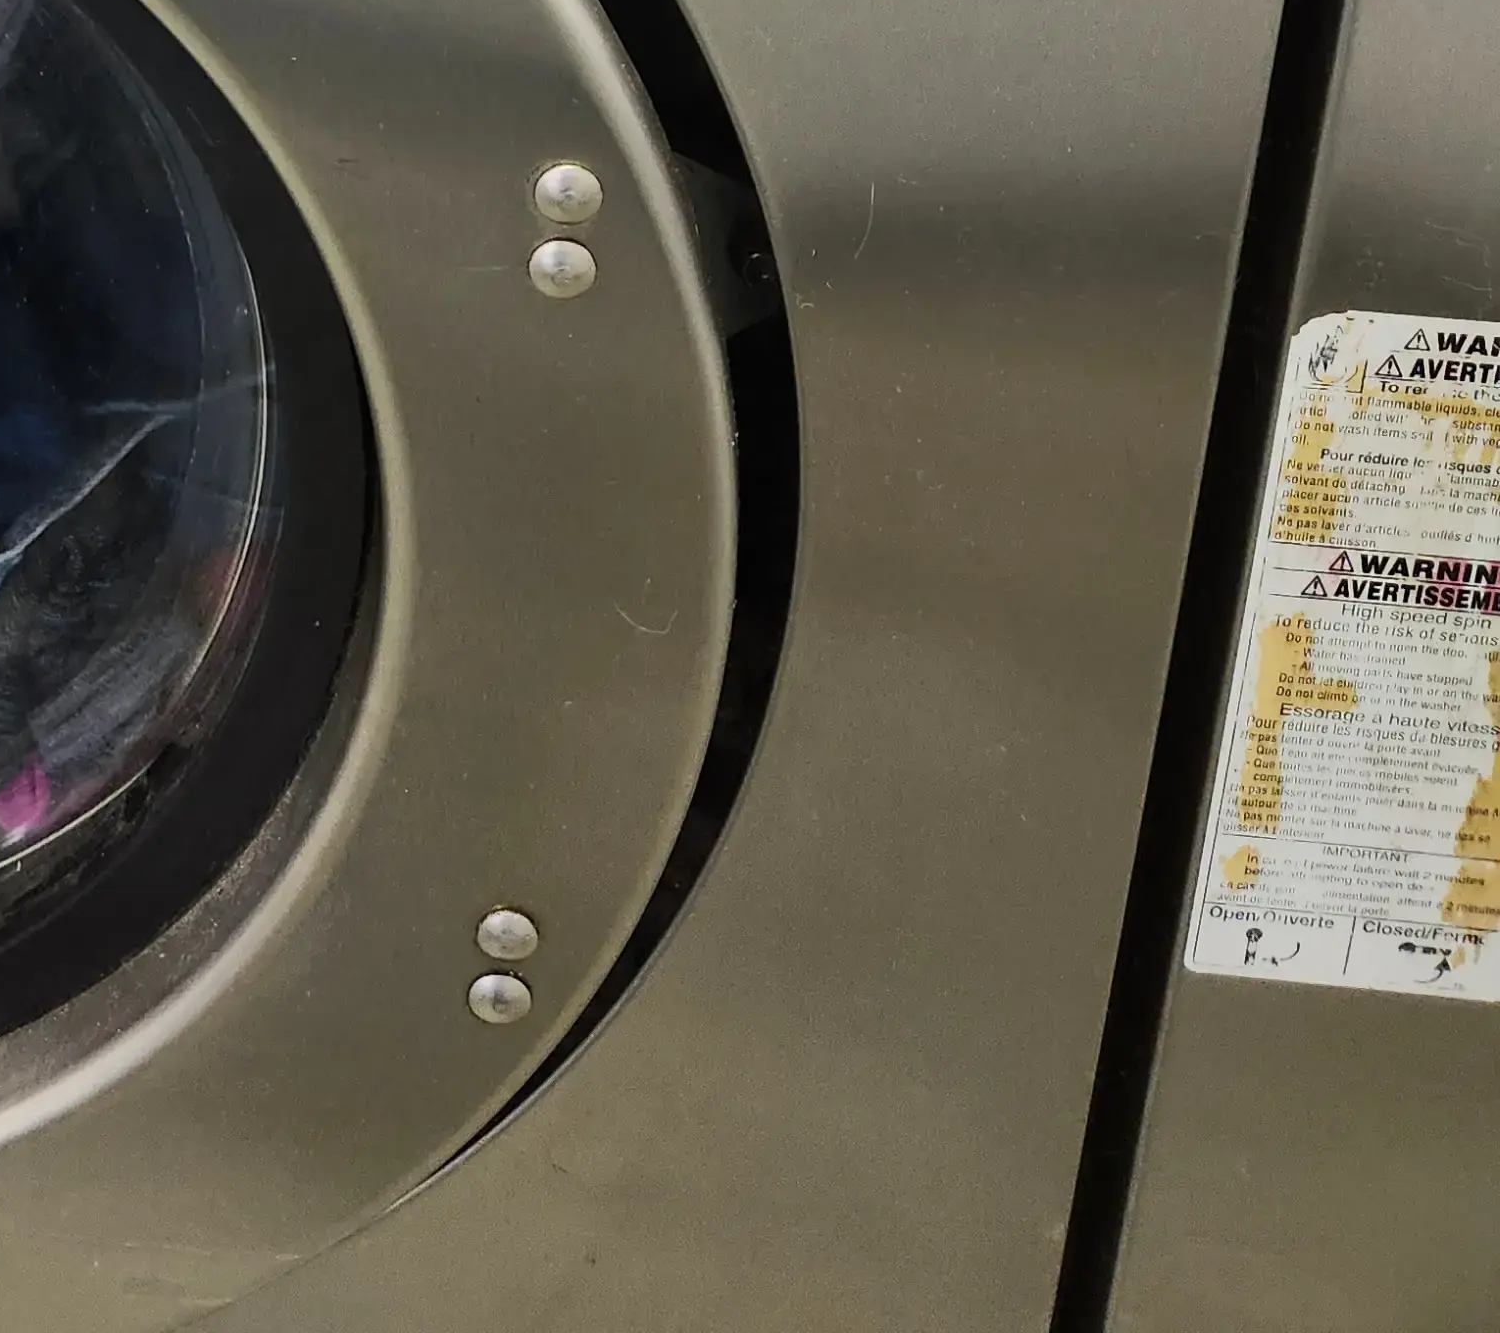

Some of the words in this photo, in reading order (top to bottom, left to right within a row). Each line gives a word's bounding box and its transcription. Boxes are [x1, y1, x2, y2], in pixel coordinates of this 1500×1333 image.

[1379, 380, 1400, 394] To
[1314, 421, 1335, 434] not
[1319, 448, 1355, 463] Pour
[1357, 451, 1409, 467] réduire
[1322, 492, 1360, 504] aucun
[1296, 519, 1318, 531] pas
[1320, 520, 1350, 532] laver
[1341, 602, 1384, 622] High
[1389, 609, 1449, 626] speed
[1452, 614, 1492, 631] spin
[1296, 616, 1351, 634] reduce
[1355, 620, 1381, 636] the
[1419, 627, 1436, 640] of
[1285, 632, 1302, 644] Do
[1305, 635, 1324, 646] not
[1278, 672, 1294, 684] Do
[1297, 675, 1316, 685] not
[1275, 685, 1292, 698] Do
[1294, 688, 1315, 700] not
[1316, 690, 1350, 703] climb
[1246, 714, 1279, 730] Pour
[1278, 700, 1367, 723] Essorage
[1387, 712, 1442, 730] haute
[1257, 733, 1278, 745] pas
[1247, 785, 1268, 796] pas
[1242, 811, 1263, 822] pas
[1321, 844, 1410, 864] IMPORTANT
